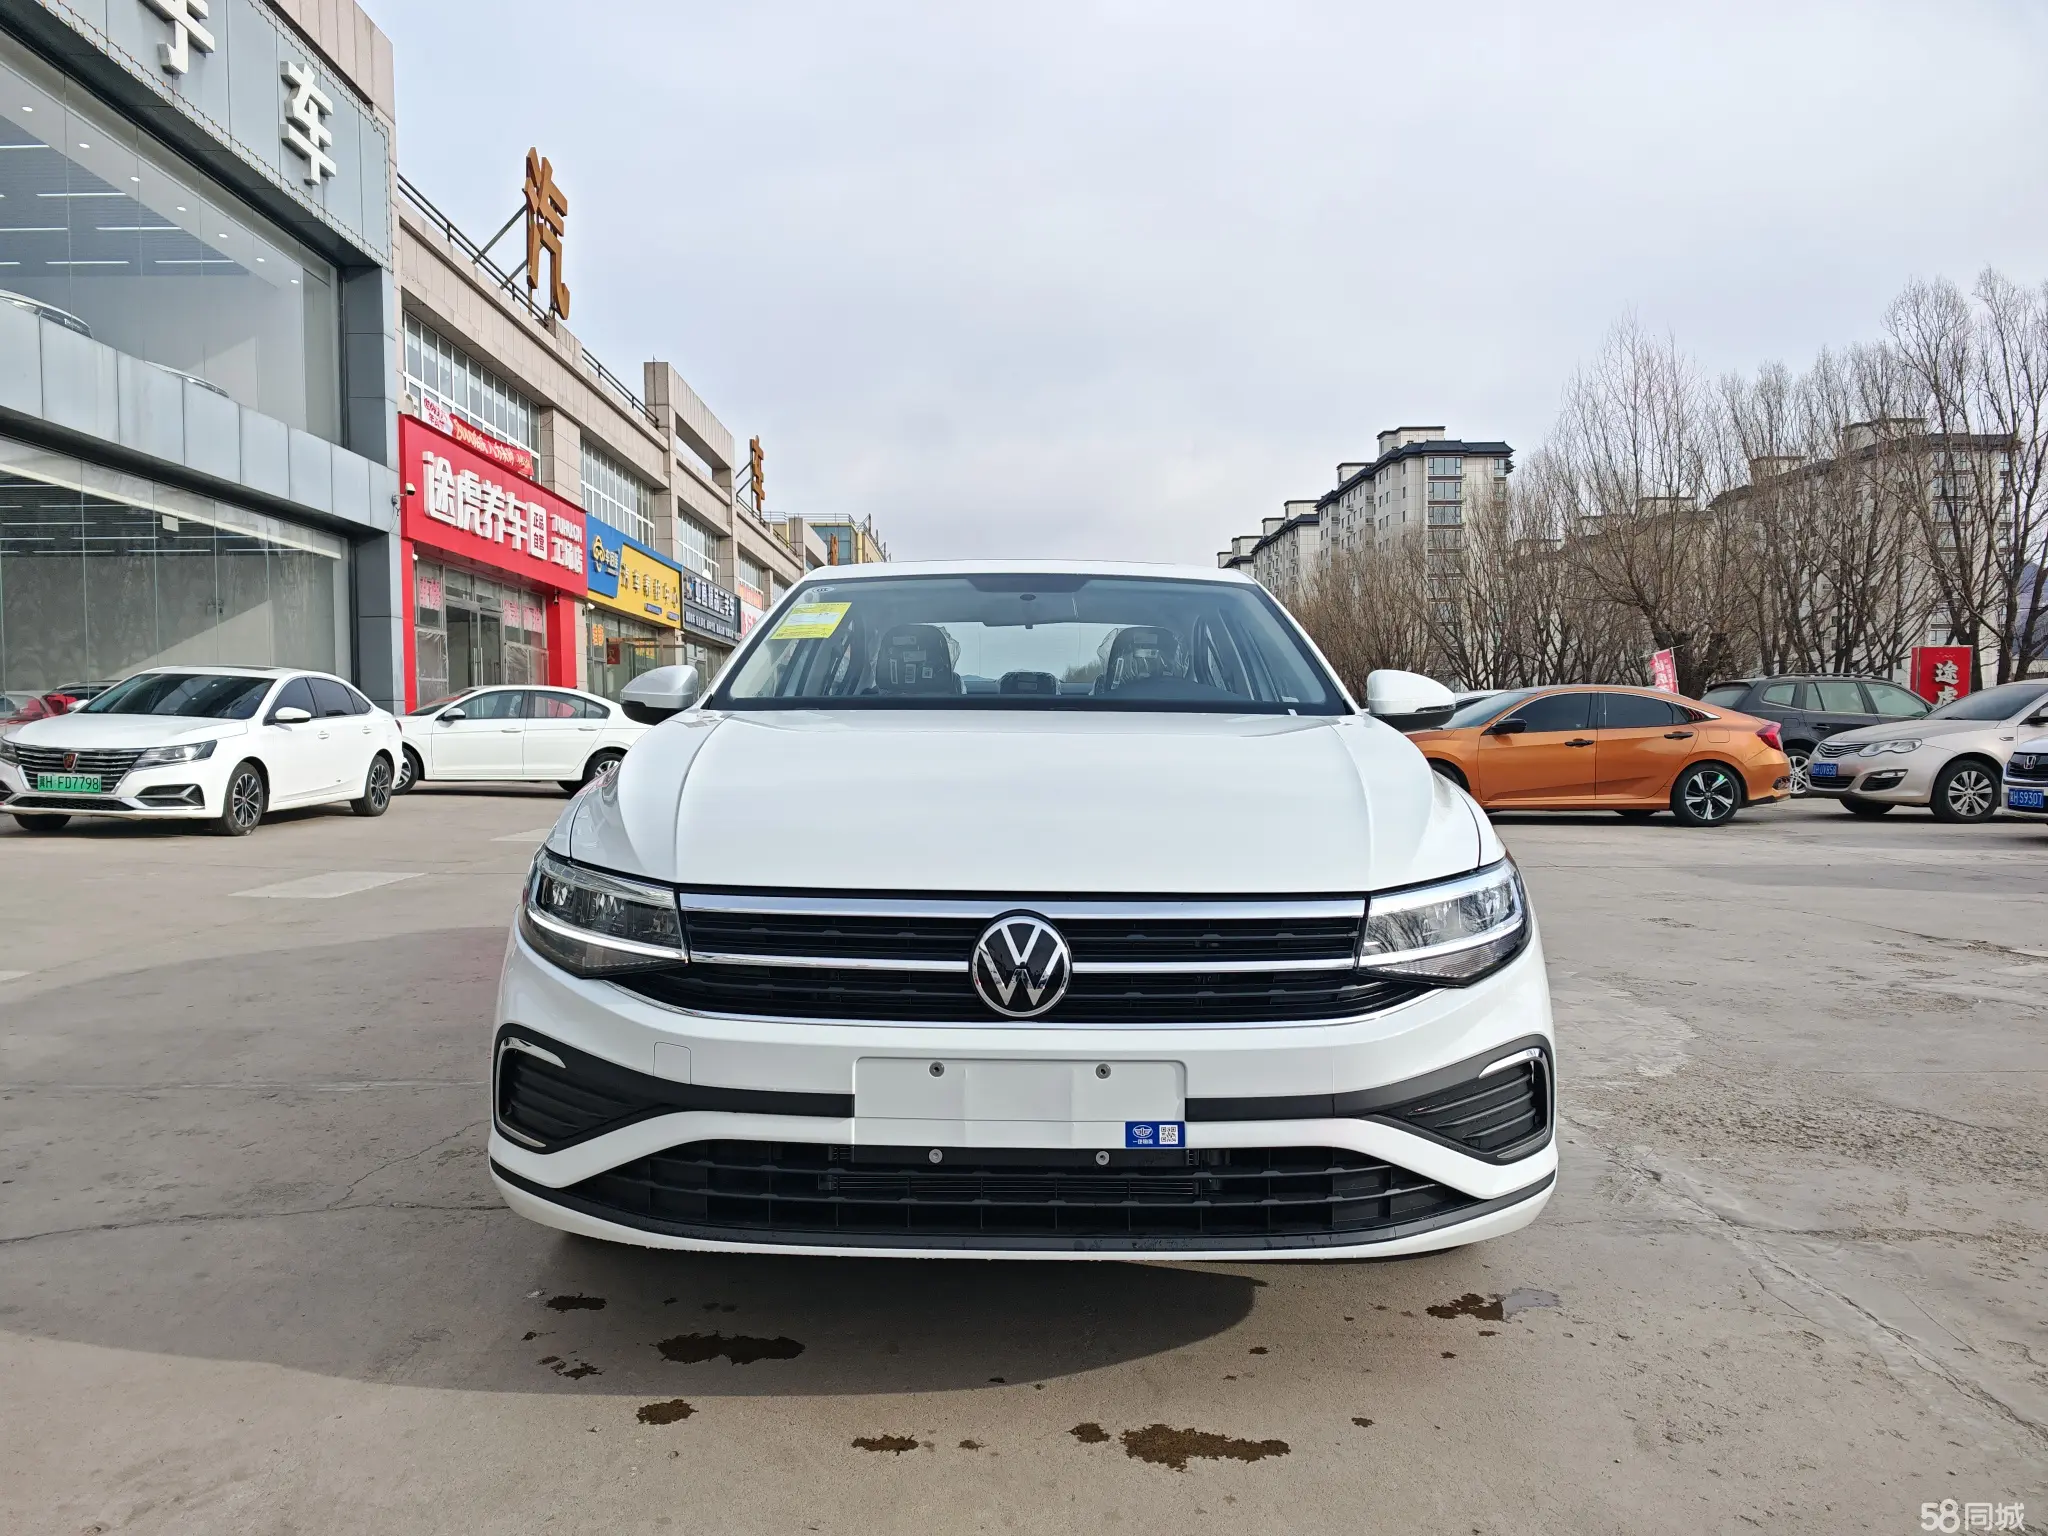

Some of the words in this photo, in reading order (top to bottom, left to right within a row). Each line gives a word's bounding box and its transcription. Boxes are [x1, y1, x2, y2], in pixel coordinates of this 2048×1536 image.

[525, 147, 570, 320] 汽
[422, 451, 528, 550] 途虎养车
[752, 434, 766, 512] 车
[533, 512, 544, 531] 正品
[533, 532, 545, 552] 自营
